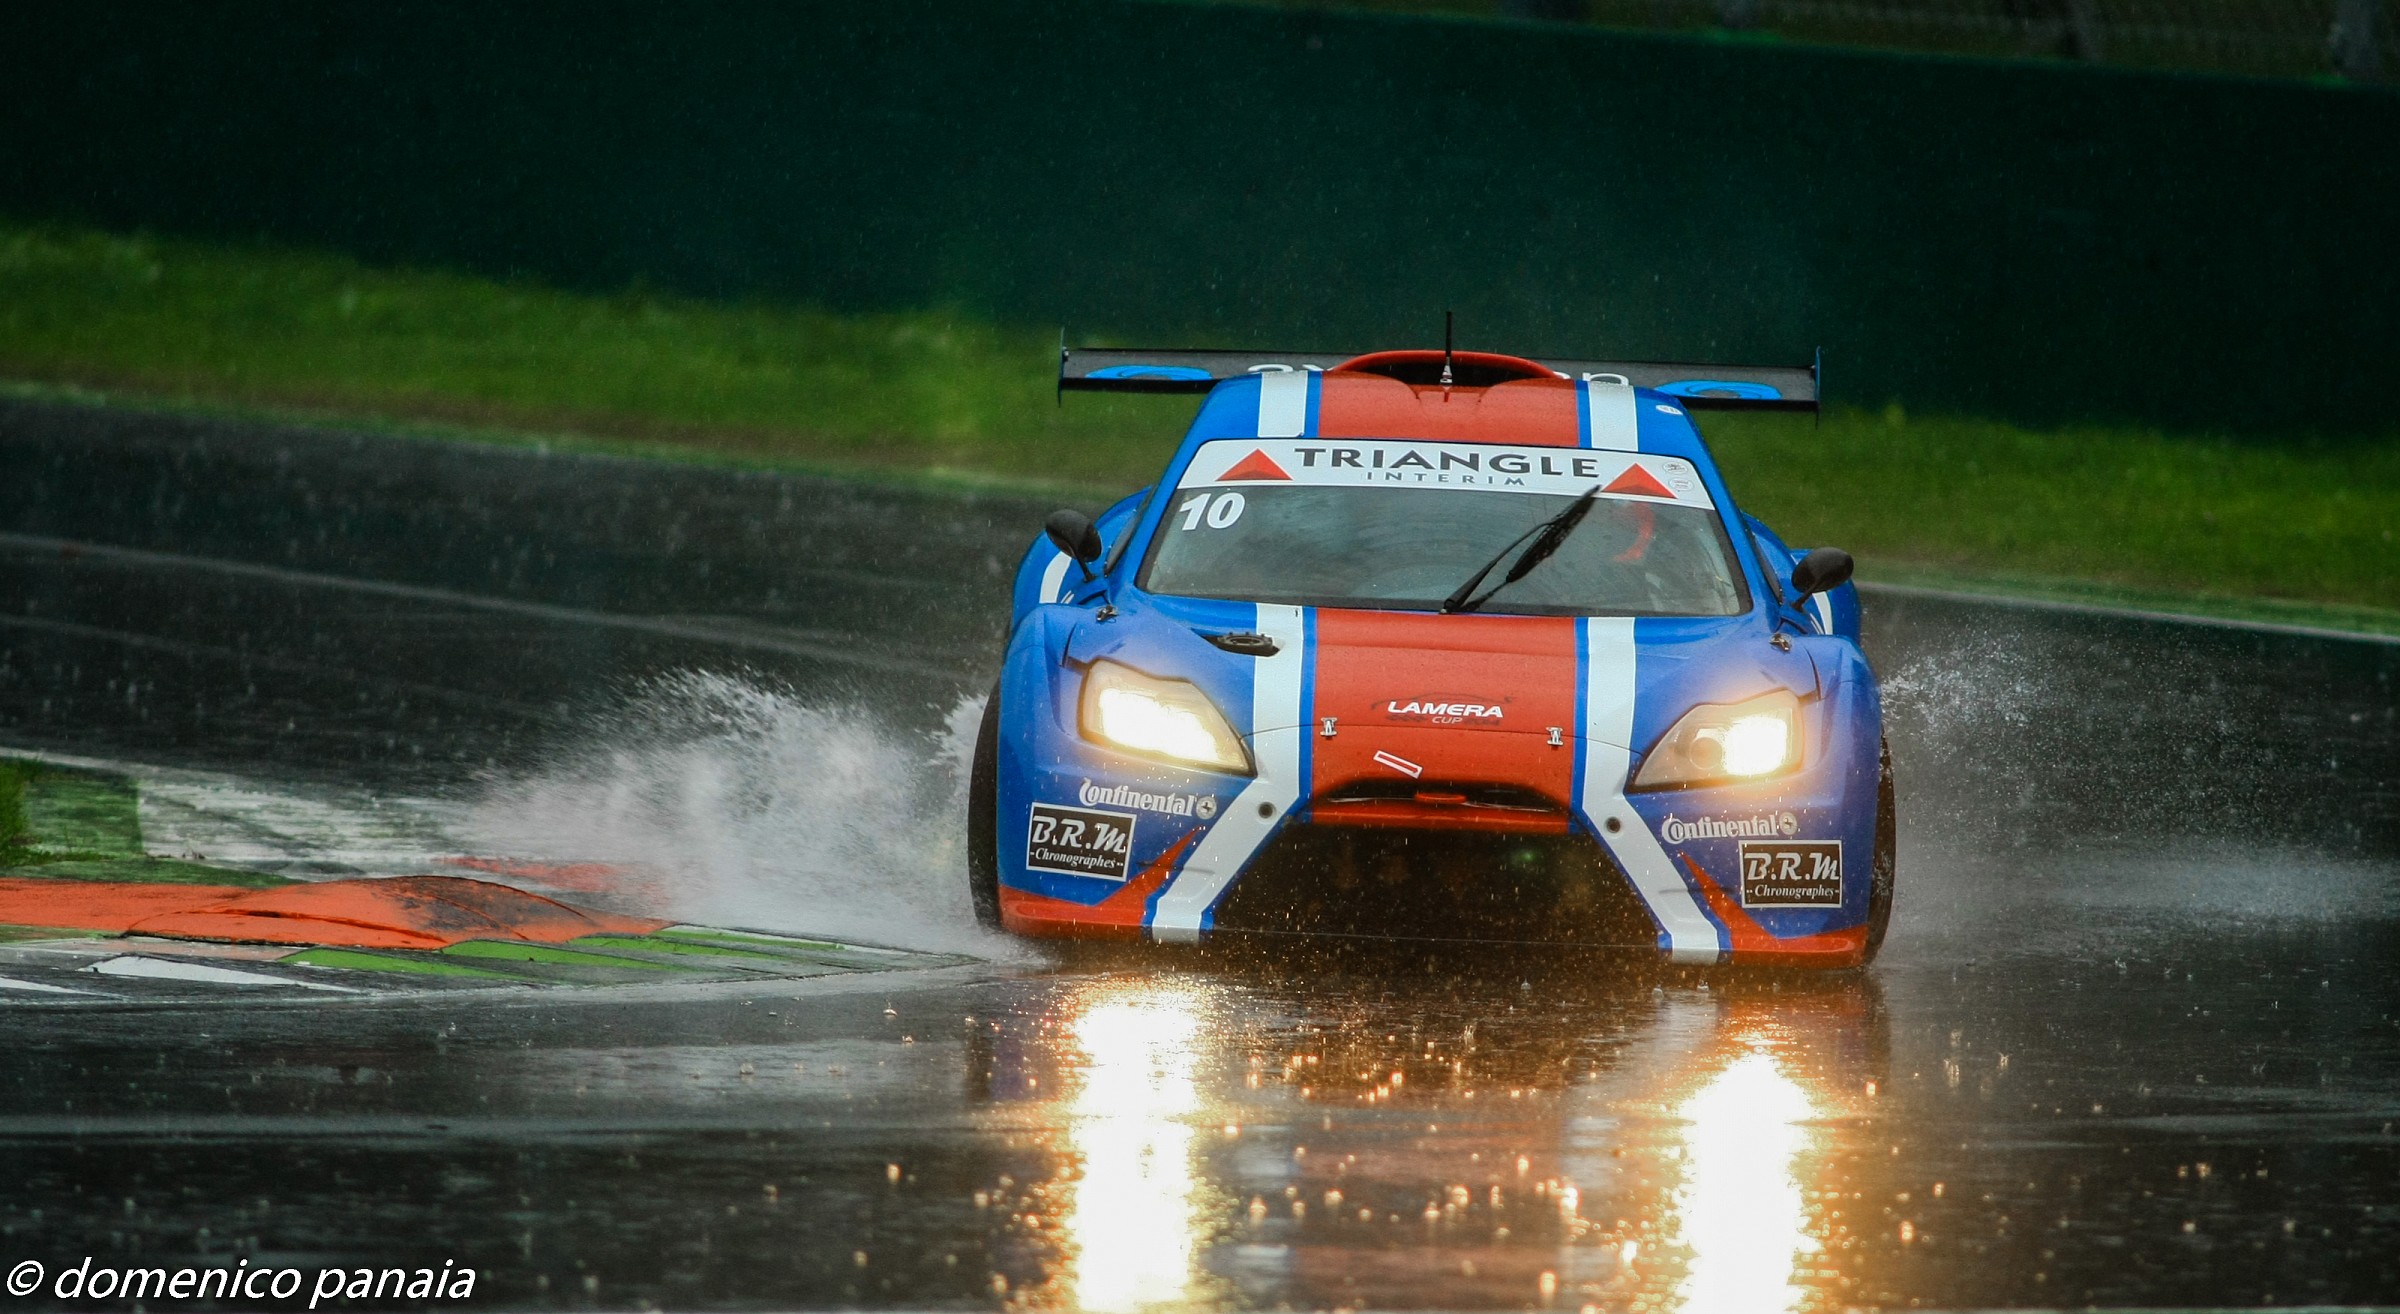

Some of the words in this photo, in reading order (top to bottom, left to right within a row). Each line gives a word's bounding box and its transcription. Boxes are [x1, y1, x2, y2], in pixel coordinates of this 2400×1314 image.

[1294, 447, 1600, 478] TRIANGLE
[1366, 471, 1525, 486] INTERIM
[1179, 492, 1246, 531] 10
[1387, 701, 1504, 718] LAMERA
[1431, 715, 1463, 725] CUP
[1079, 777, 1194, 817] Continental
[1661, 814, 1779, 845] Continental
